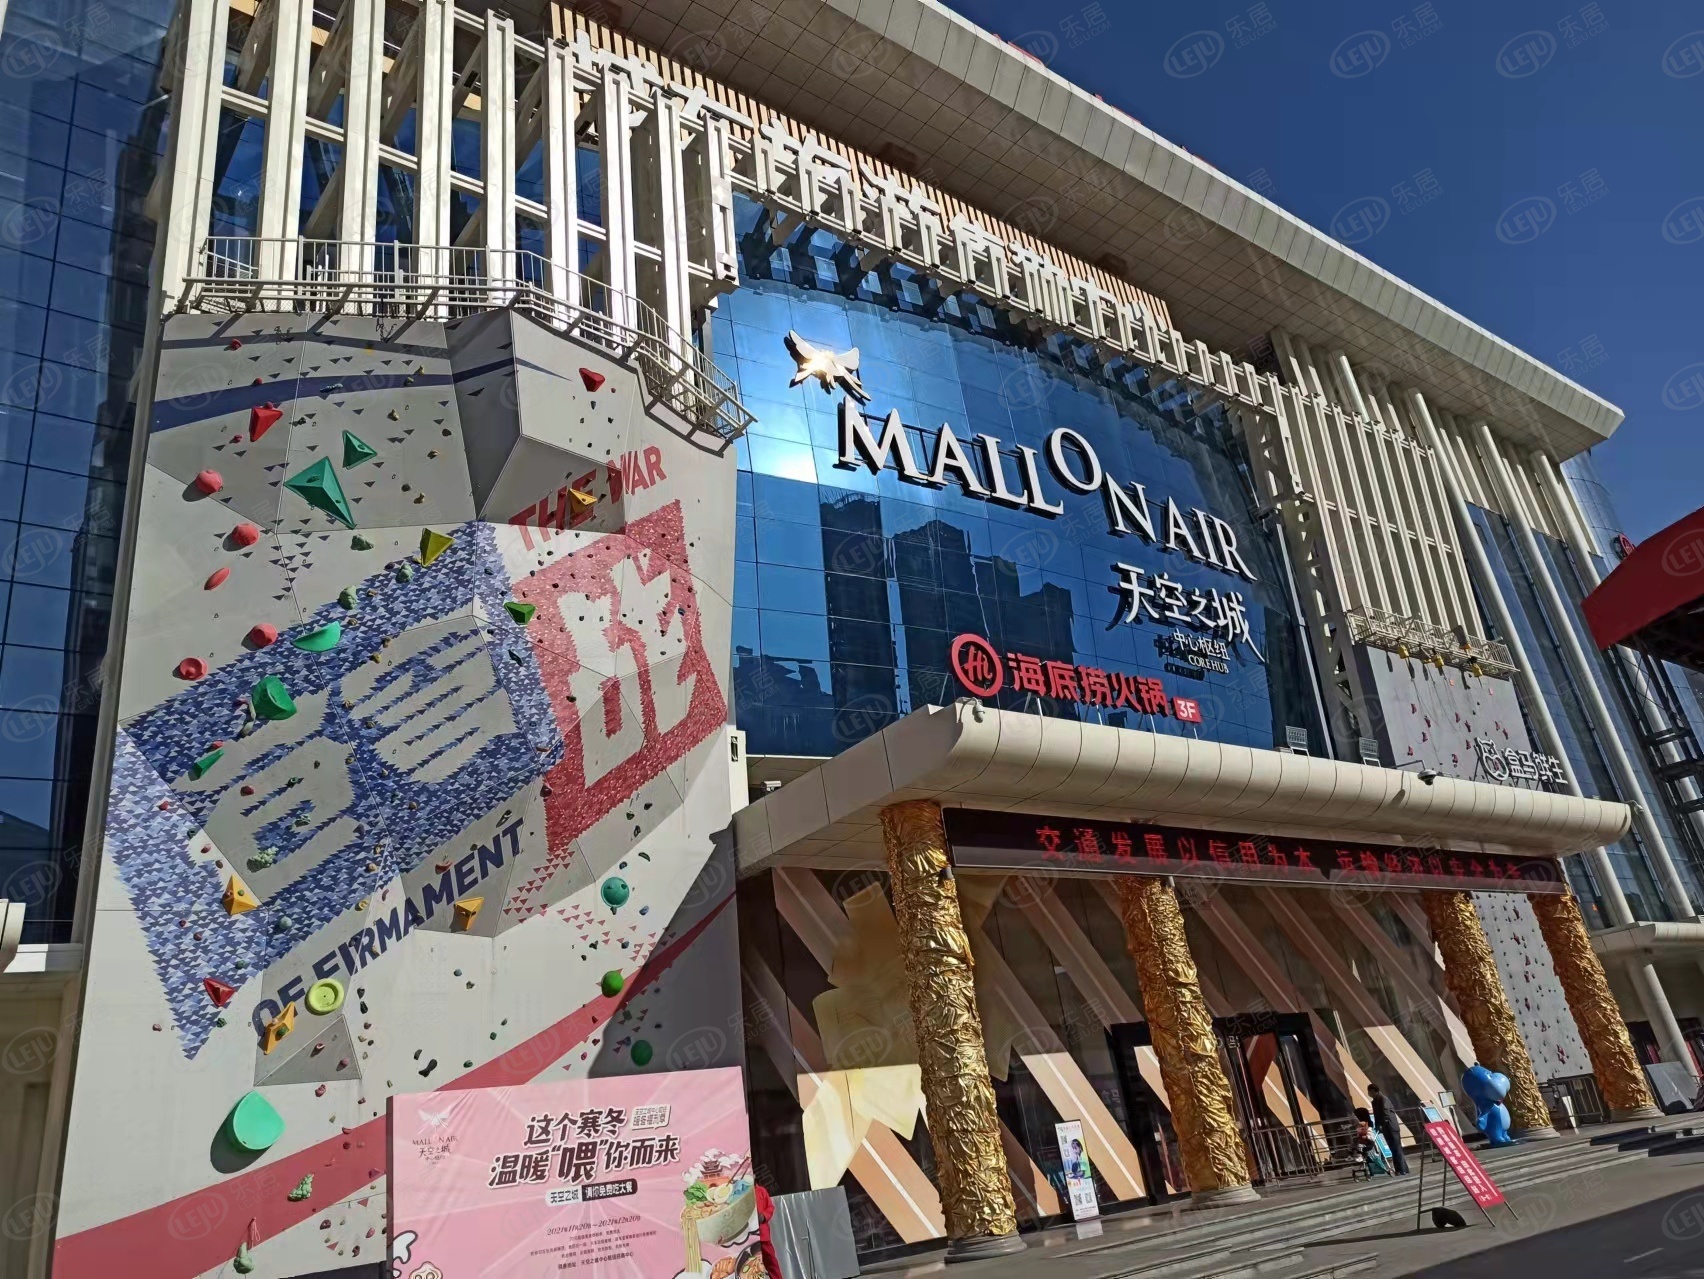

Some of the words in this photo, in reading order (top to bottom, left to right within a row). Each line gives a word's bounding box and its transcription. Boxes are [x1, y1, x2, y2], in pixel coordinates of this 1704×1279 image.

[508, 468, 598, 552] THE
[607, 445, 667, 505] WAR
[1115, 562, 1266, 664] 天空之城
[1173, 627, 1231, 661] 中心枢纽
[1006, 651, 1170, 718] 海底捞火锅
[1176, 699, 1197, 719] 3F
[1503, 747, 1569, 784] 盒马鲜生
[1035, 825, 1317, 874] 交通发展以信用为本
[311, 816, 525, 981] FIRMAMENT
[523, 1107, 627, 1146] 这个寒冬
[550, 1188, 580, 1204] 天空之城
[584, 1180, 634, 1199] 请你免费吃大餐
